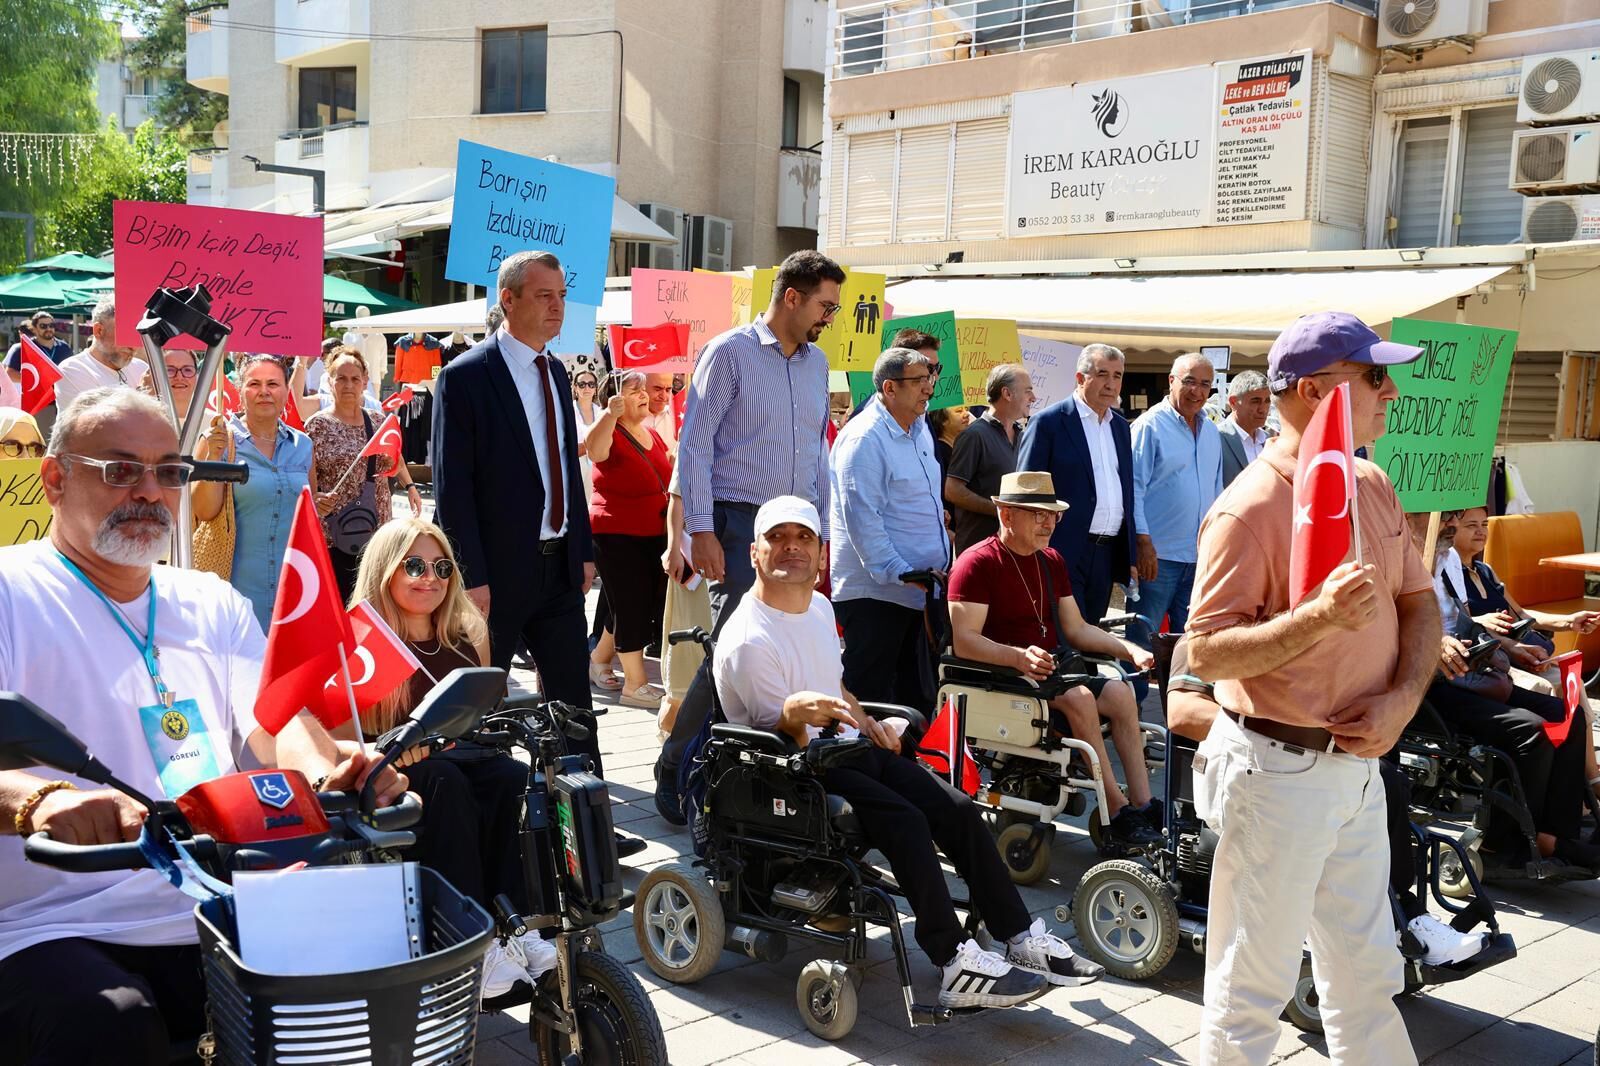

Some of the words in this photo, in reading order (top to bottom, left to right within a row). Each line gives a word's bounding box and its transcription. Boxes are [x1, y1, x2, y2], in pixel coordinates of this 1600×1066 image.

[1239, 66, 1261, 79] LAZER
[1262, 60, 1303, 75] EPİLASYON
[1225, 86, 1243, 100] LEKE
[1243, 89, 1250, 98] ve
[1251, 83, 1265, 97] BEN
[1266, 80, 1287, 95] SİLME
[1229, 103, 1255, 116] Çatlak
[1258, 99, 1292, 111] Tedavisi
[1222, 118, 1244, 127] ALTIN
[1246, 116, 1268, 124] ORAN
[1241, 126, 1257, 134] KAŞ
[1259, 123, 1281, 132] ALIMI
[1219, 137, 1267, 147] PROFESYONEL
[1236, 144, 1275, 154] TEDAVİLERİ
[1023, 154, 1074, 174] İREM
[1081, 139, 1200, 169] KARAOĞLU
[1243, 154, 1271, 162] MAKYAJ
[478, 159, 547, 203] Barışın
[1218, 173, 1233, 181] İPEK
[1218, 181, 1246, 189] KERATİN
[1248, 179, 1271, 187] BOTOX
[1050, 181, 1105, 200] Beauty
[1217, 190, 1251, 198] BÖLGESEL
[1253, 186, 1292, 195] ZAYIFLAMA
[1231, 195, 1286, 204] RENKLENDİRME
[1028, 216, 1049, 226] 0552
[1051, 215, 1068, 225] 203
[1070, 214, 1081, 224] 53
[1084, 213, 1095, 223] 38
[1115, 208, 1201, 222] iremkaraoglubeauty
[486, 200, 566, 246] İzdüşümü
[125, 215, 191, 251] Bizim
[243, 233, 300, 263] Değil,
[657, 279, 689, 304] Eşitlik
[1411, 339, 1459, 382] ENGEL
[1388, 395, 1452, 436] BEDENDE
[170, 748, 200, 762] GÖREVLİ
[1009, 953, 1047, 972] adidas
